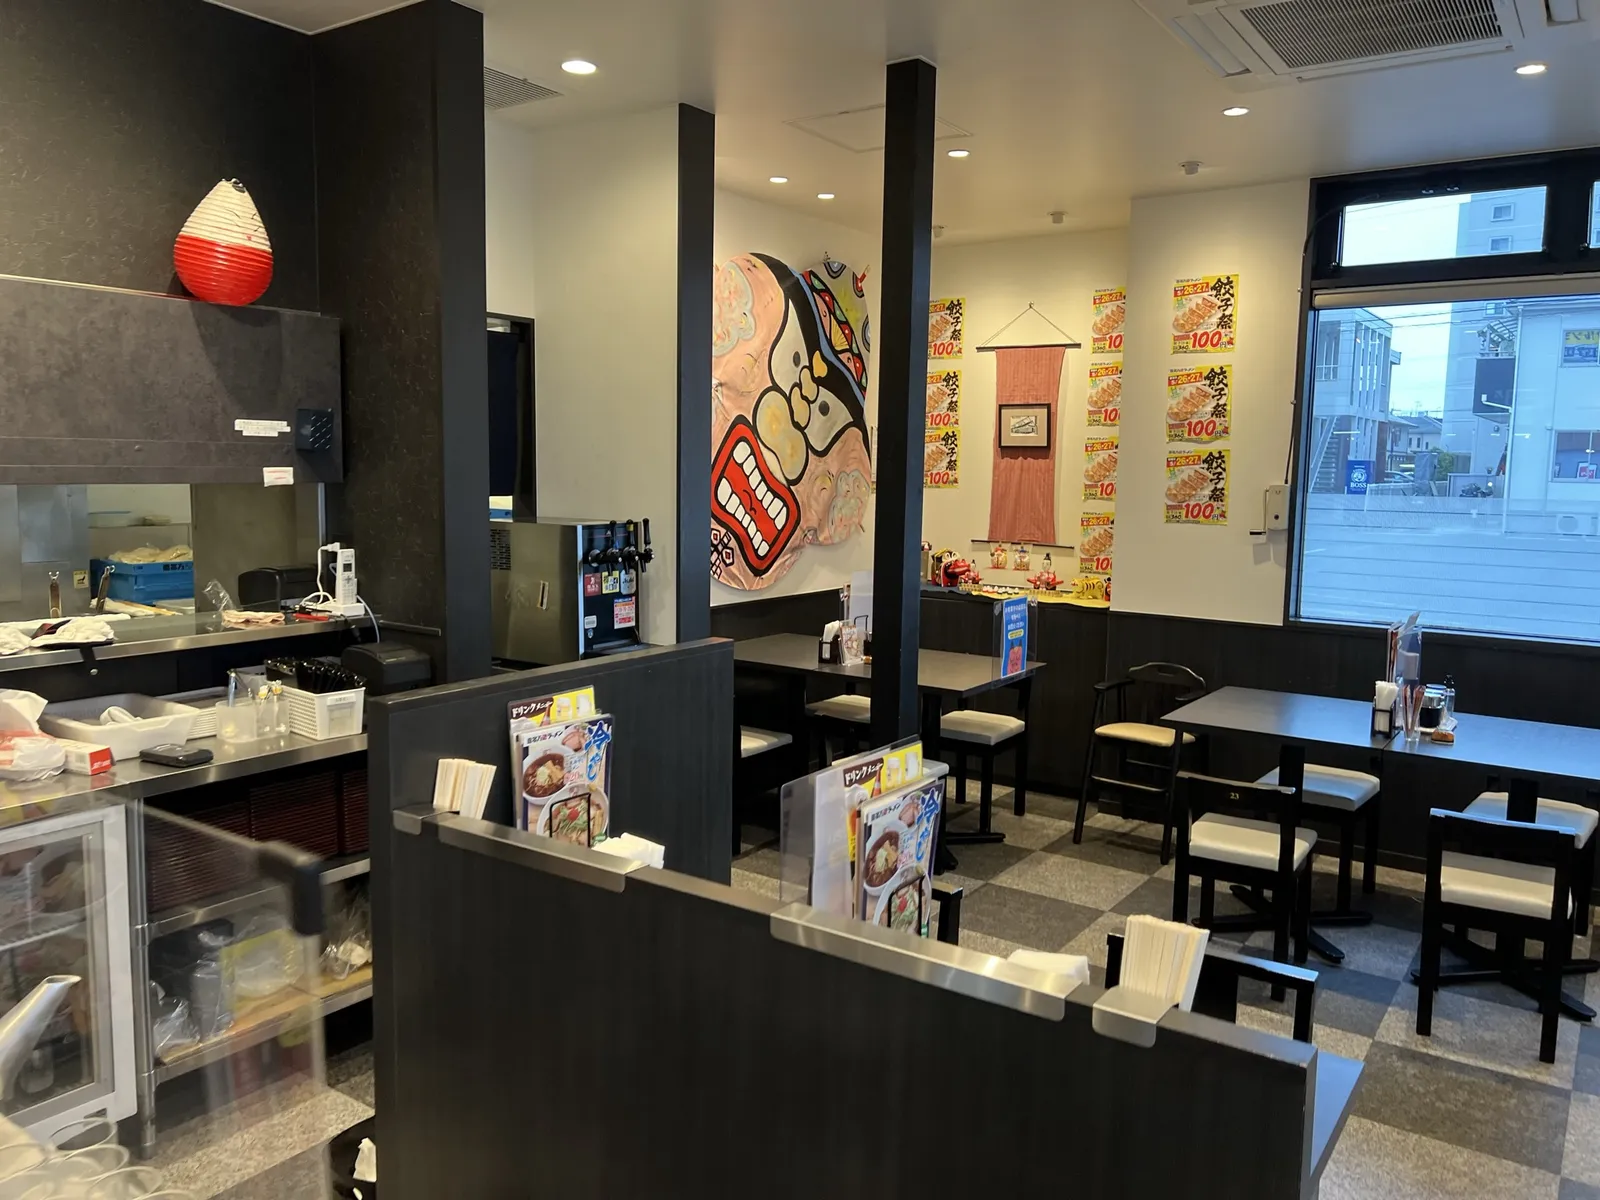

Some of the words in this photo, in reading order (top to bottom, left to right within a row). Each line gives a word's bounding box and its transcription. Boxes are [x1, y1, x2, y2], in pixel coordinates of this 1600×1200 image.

[946, 299, 962, 341] 餃子祭
[1211, 276, 1234, 329] 餃子祭
[1107, 334, 1124, 349] 10
[943, 371, 958, 412] 餃子祭
[1204, 366, 1228, 418] 餃子祭
[1103, 408, 1120, 423] 10
[941, 431, 957, 471] 餃子祭
[1099, 482, 1116, 496] 10
[1203, 451, 1226, 502] 餃子祭
[1095, 557, 1112, 571] 10
[584, 721, 611, 781] 冷やし
[915, 788, 939, 862] 冷やし
